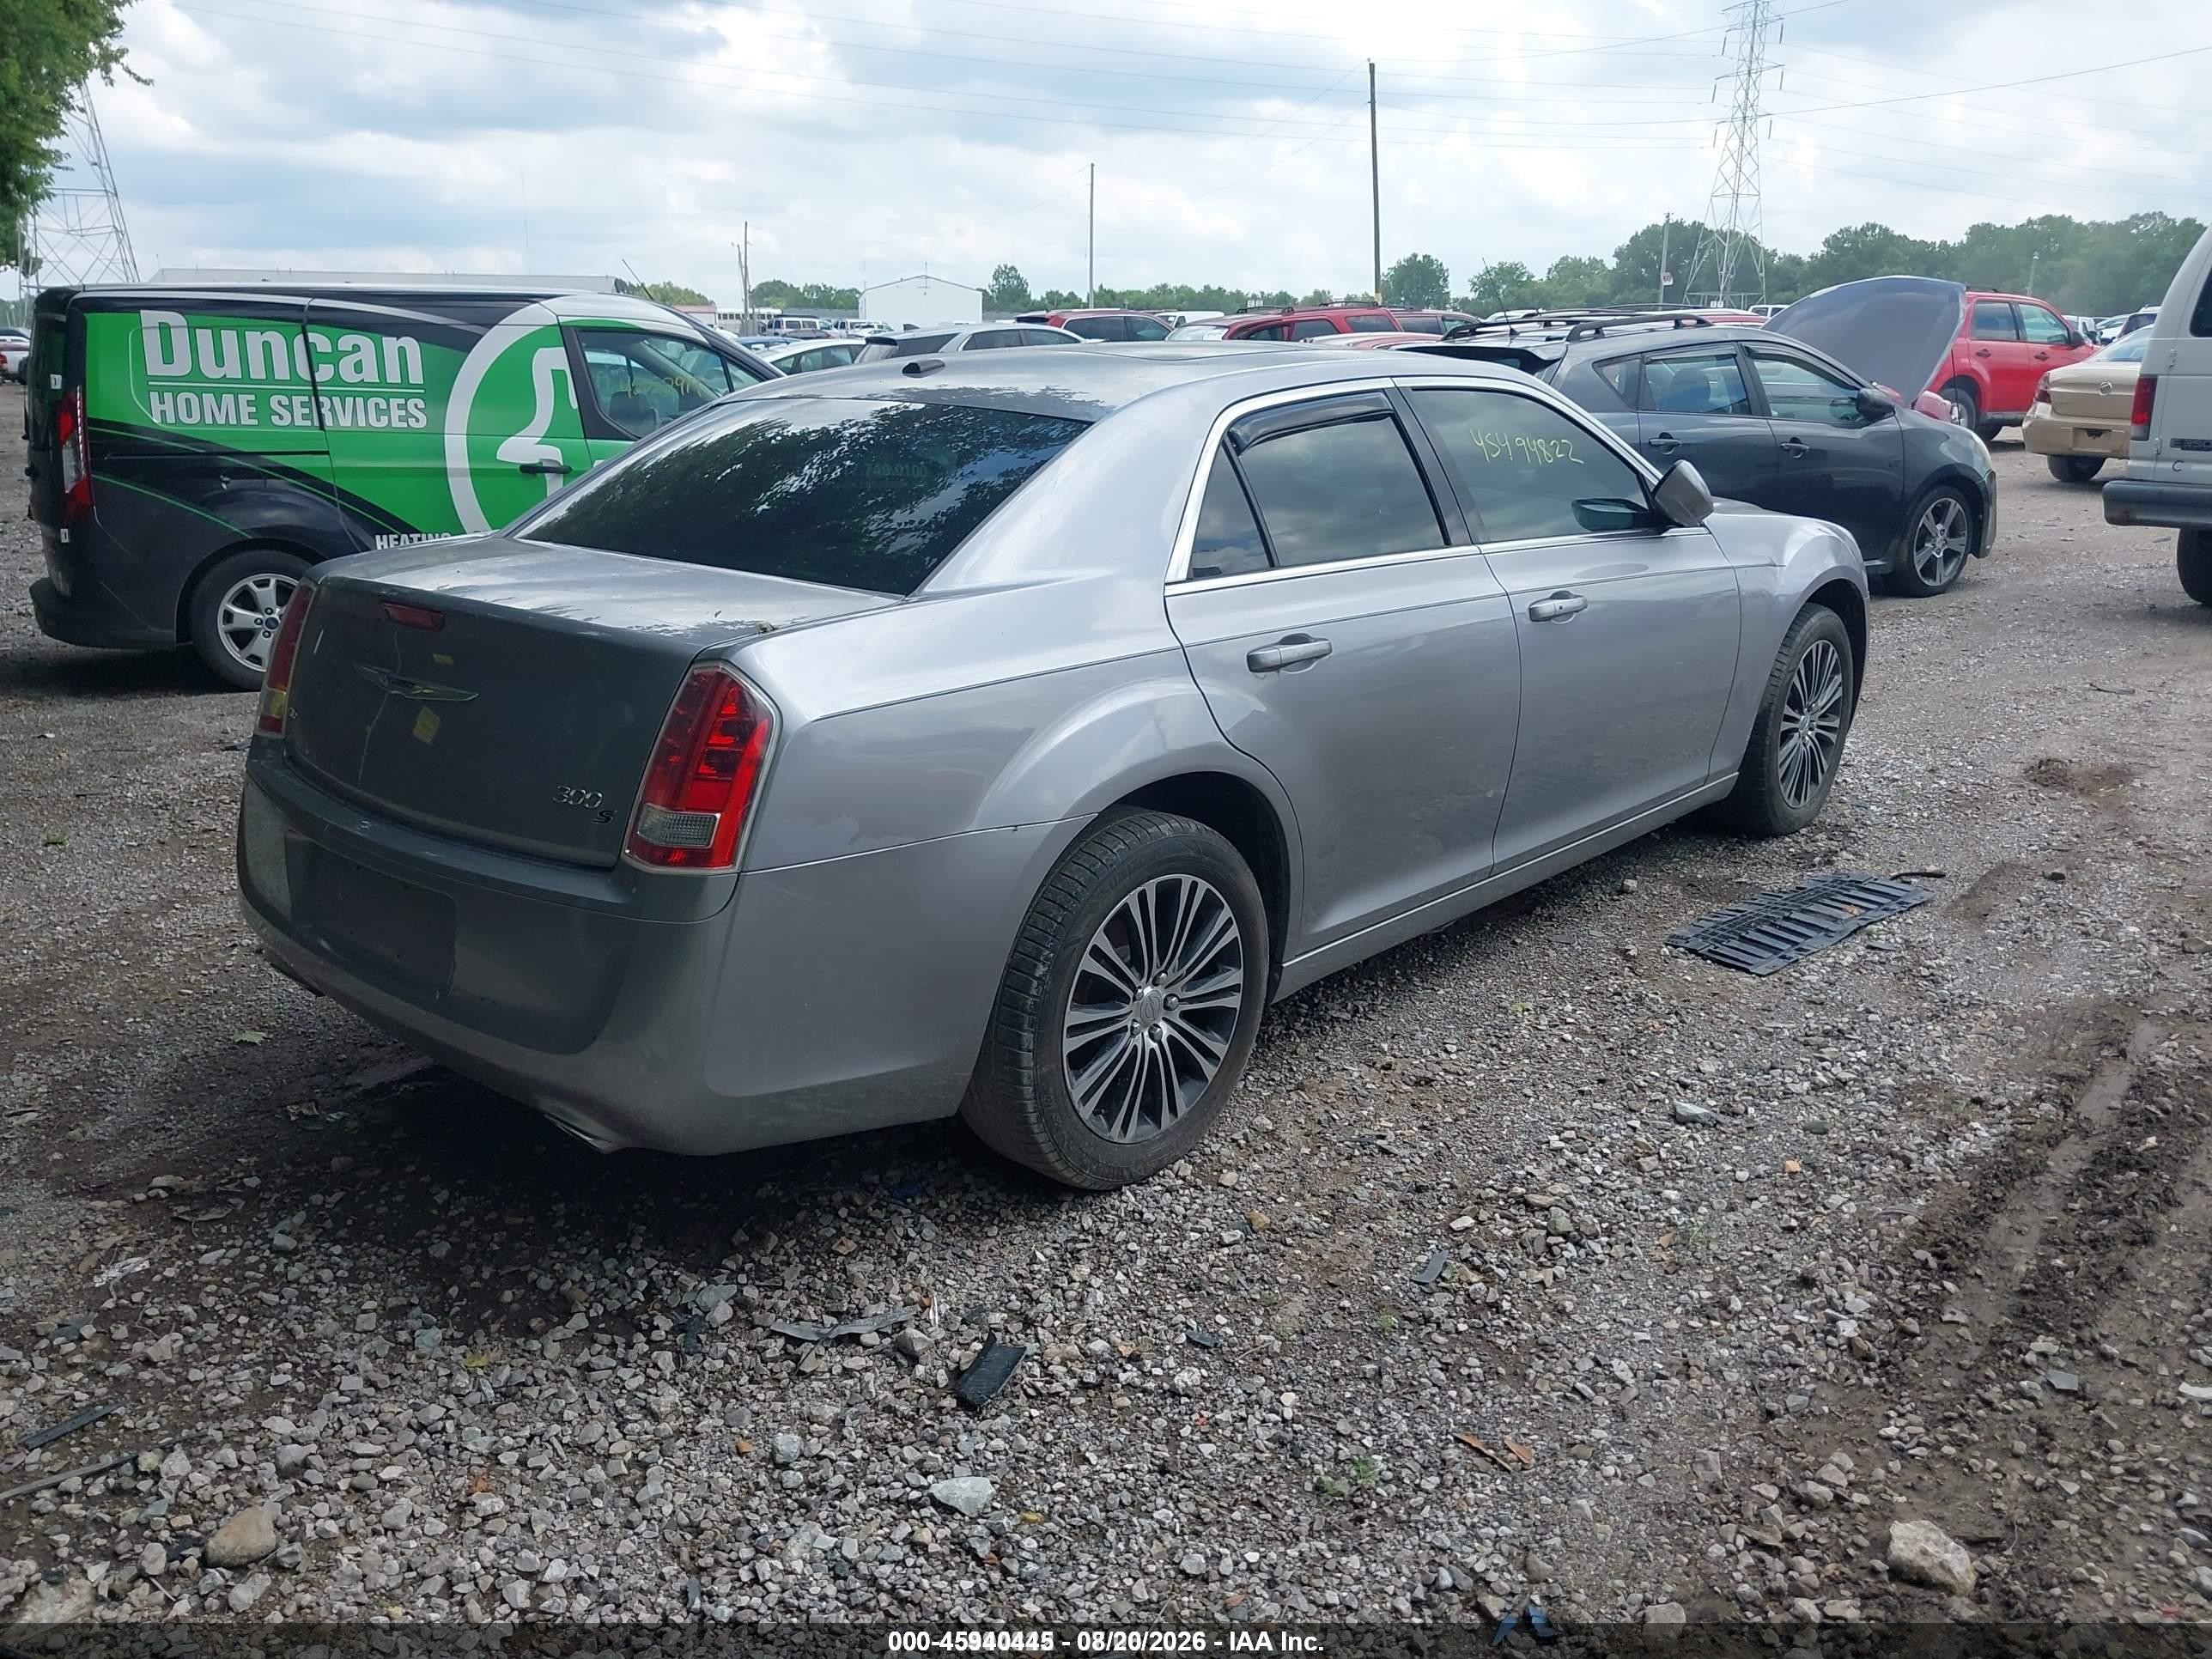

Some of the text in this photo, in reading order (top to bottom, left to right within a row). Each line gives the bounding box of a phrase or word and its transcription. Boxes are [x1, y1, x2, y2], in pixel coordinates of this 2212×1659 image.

[140, 309, 425, 385] Duncan
[149, 391, 428, 428] HOME SERVICES
[374, 532, 452, 550] HEATIN
[551, 785, 604, 809] 300
[590, 809, 618, 824] S
